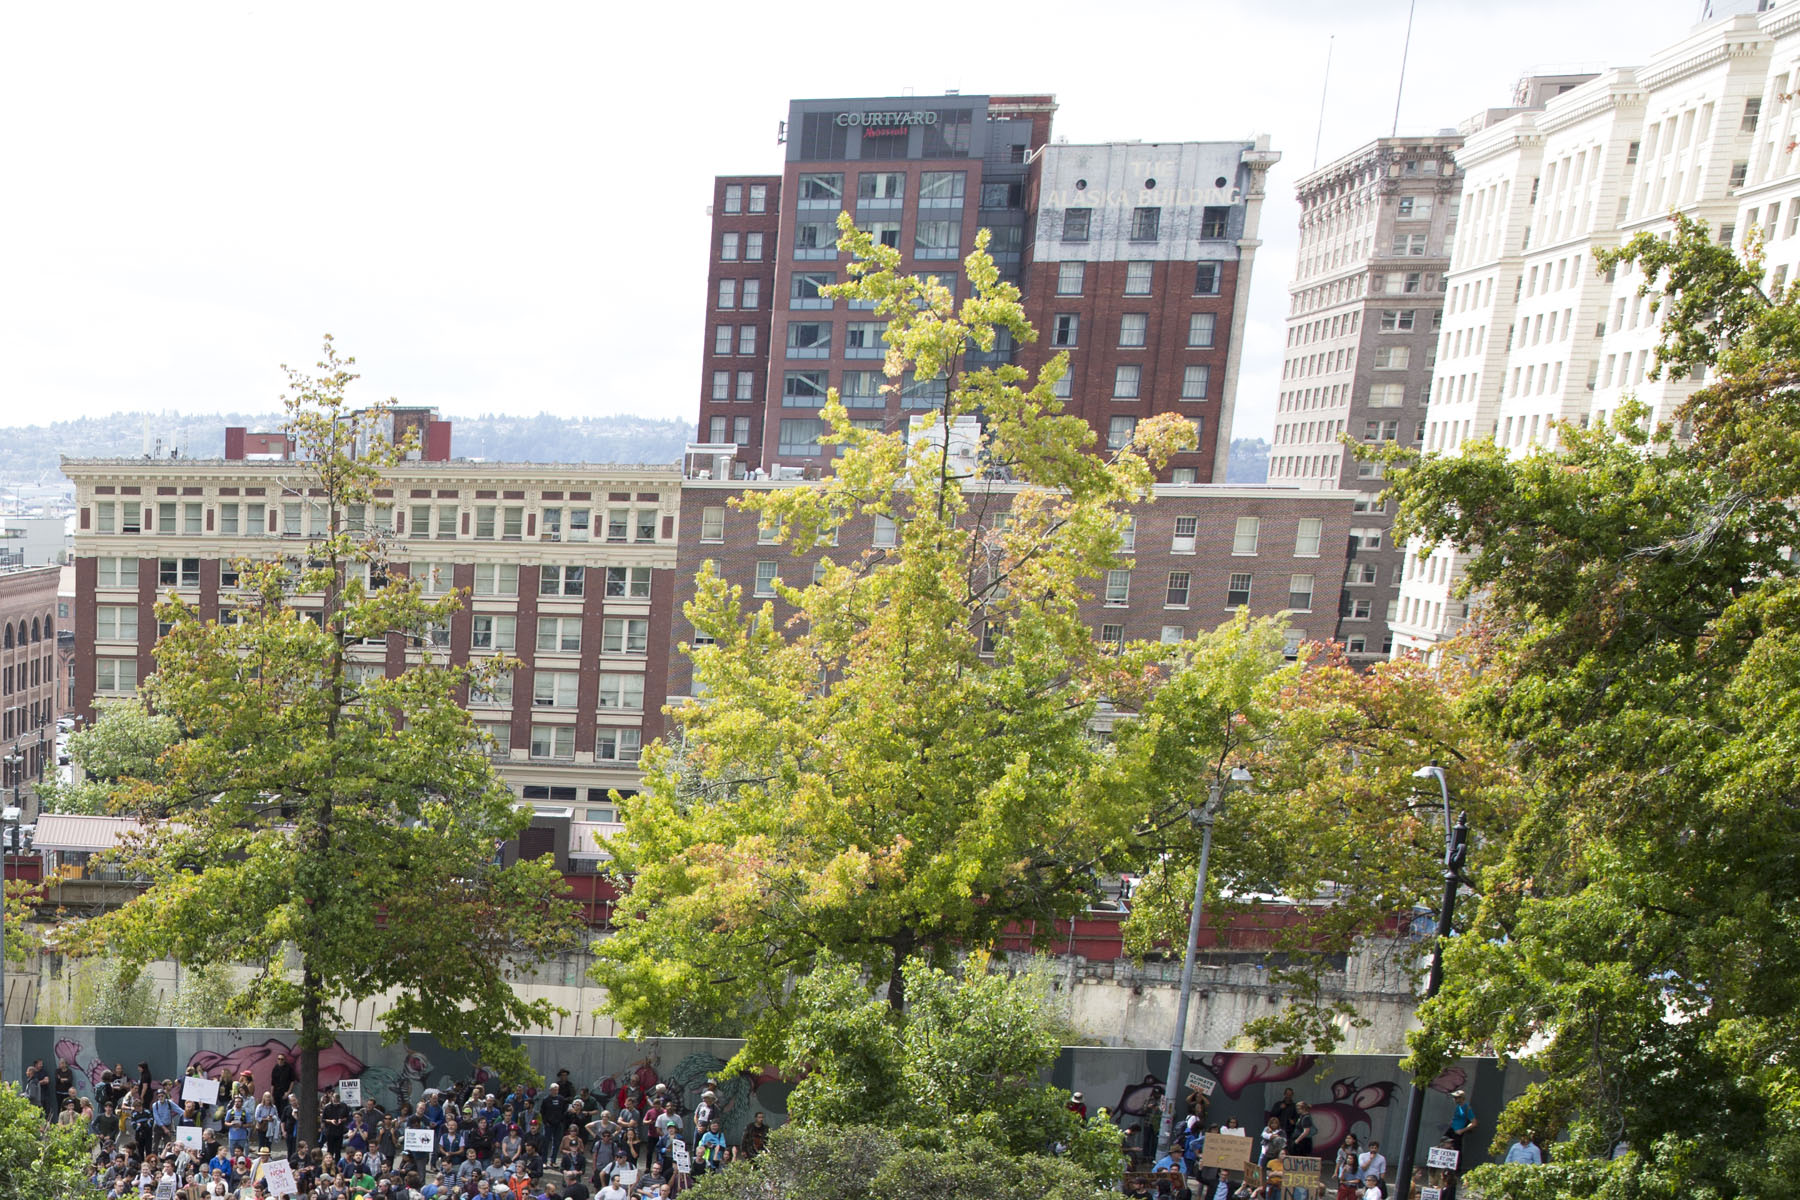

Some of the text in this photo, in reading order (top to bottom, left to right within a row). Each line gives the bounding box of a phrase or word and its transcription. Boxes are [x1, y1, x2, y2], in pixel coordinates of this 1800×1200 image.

[836, 110, 938, 127] COURTYARD
[1131, 161, 1175, 178] THE
[1047, 186, 1241, 208] ALASKA BUILDING
[1190, 1074, 1214, 1087] CLIMATE
[270, 1168, 287, 1177] NOW
[1283, 1157, 1321, 1172] CLIMATE
